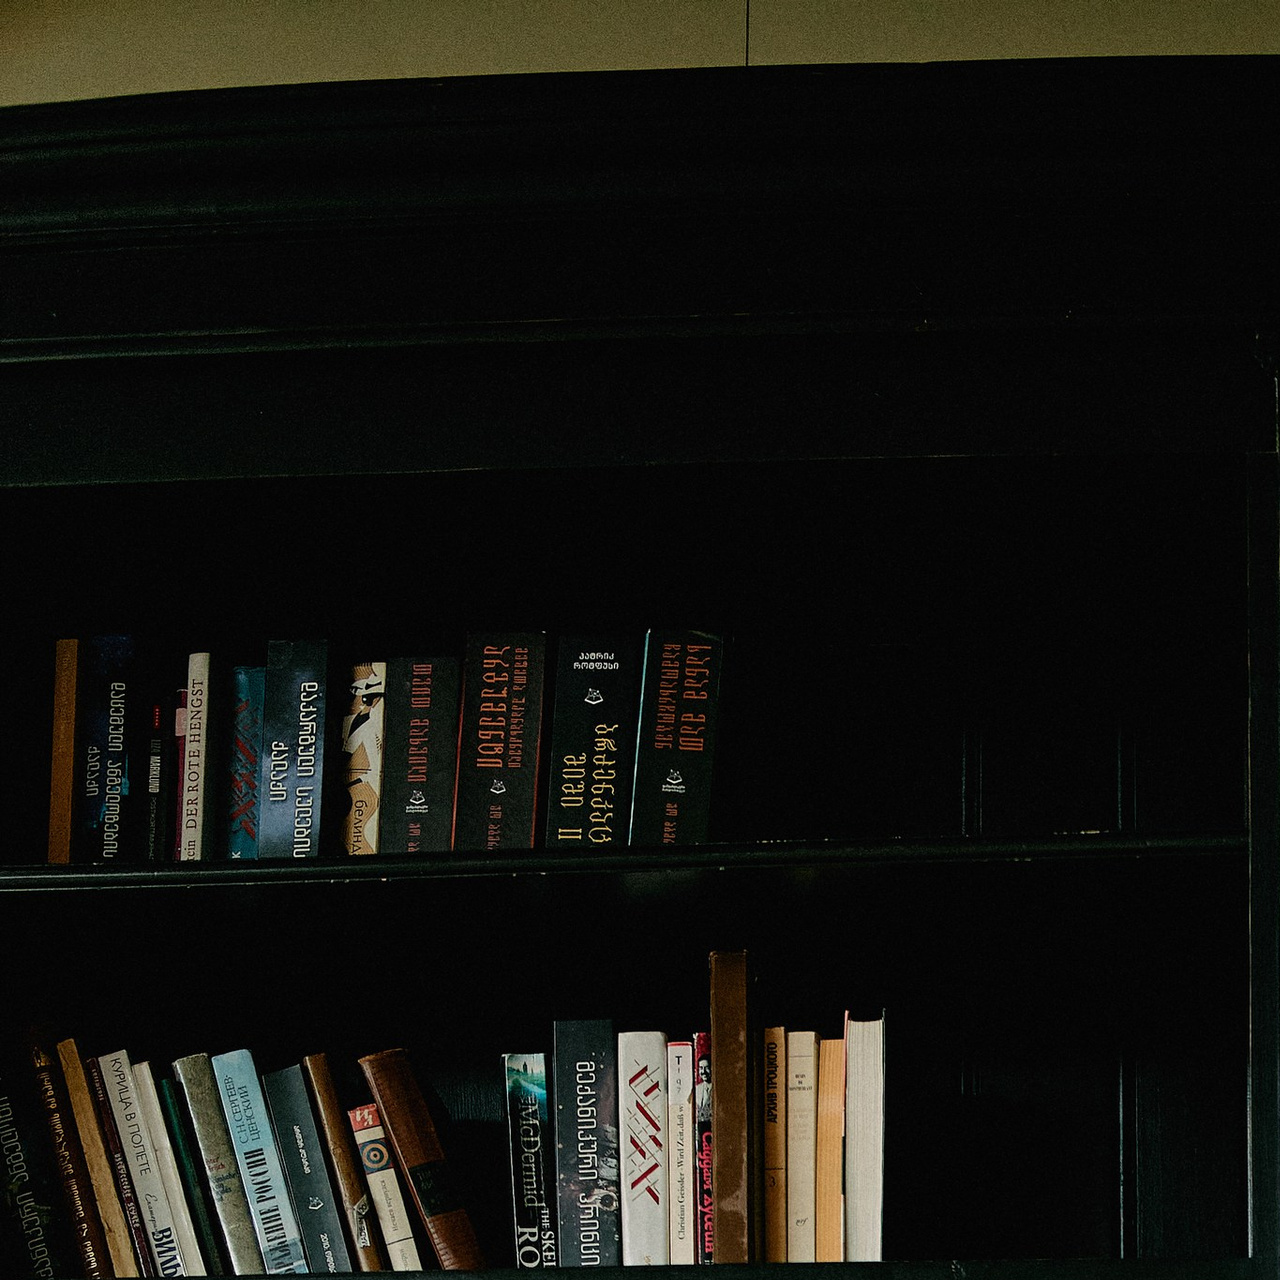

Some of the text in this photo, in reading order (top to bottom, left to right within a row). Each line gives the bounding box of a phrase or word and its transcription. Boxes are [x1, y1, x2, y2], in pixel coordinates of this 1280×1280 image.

[149, 756, 160, 793] MARKLUND
[558, 827, 582, 840] II
[766, 1042, 778, 1125] АРХИВ ТРОЦКОГО
[111, 1057, 151, 1175] КУРИЦА В ПОЛЕТЕ
[239, 1086, 261, 1141] ЦЕНСКИЙ
[517, 1096, 542, 1207] McDermid
[769, 1176, 777, 1188] 3
[540, 1208, 549, 1231] THE
